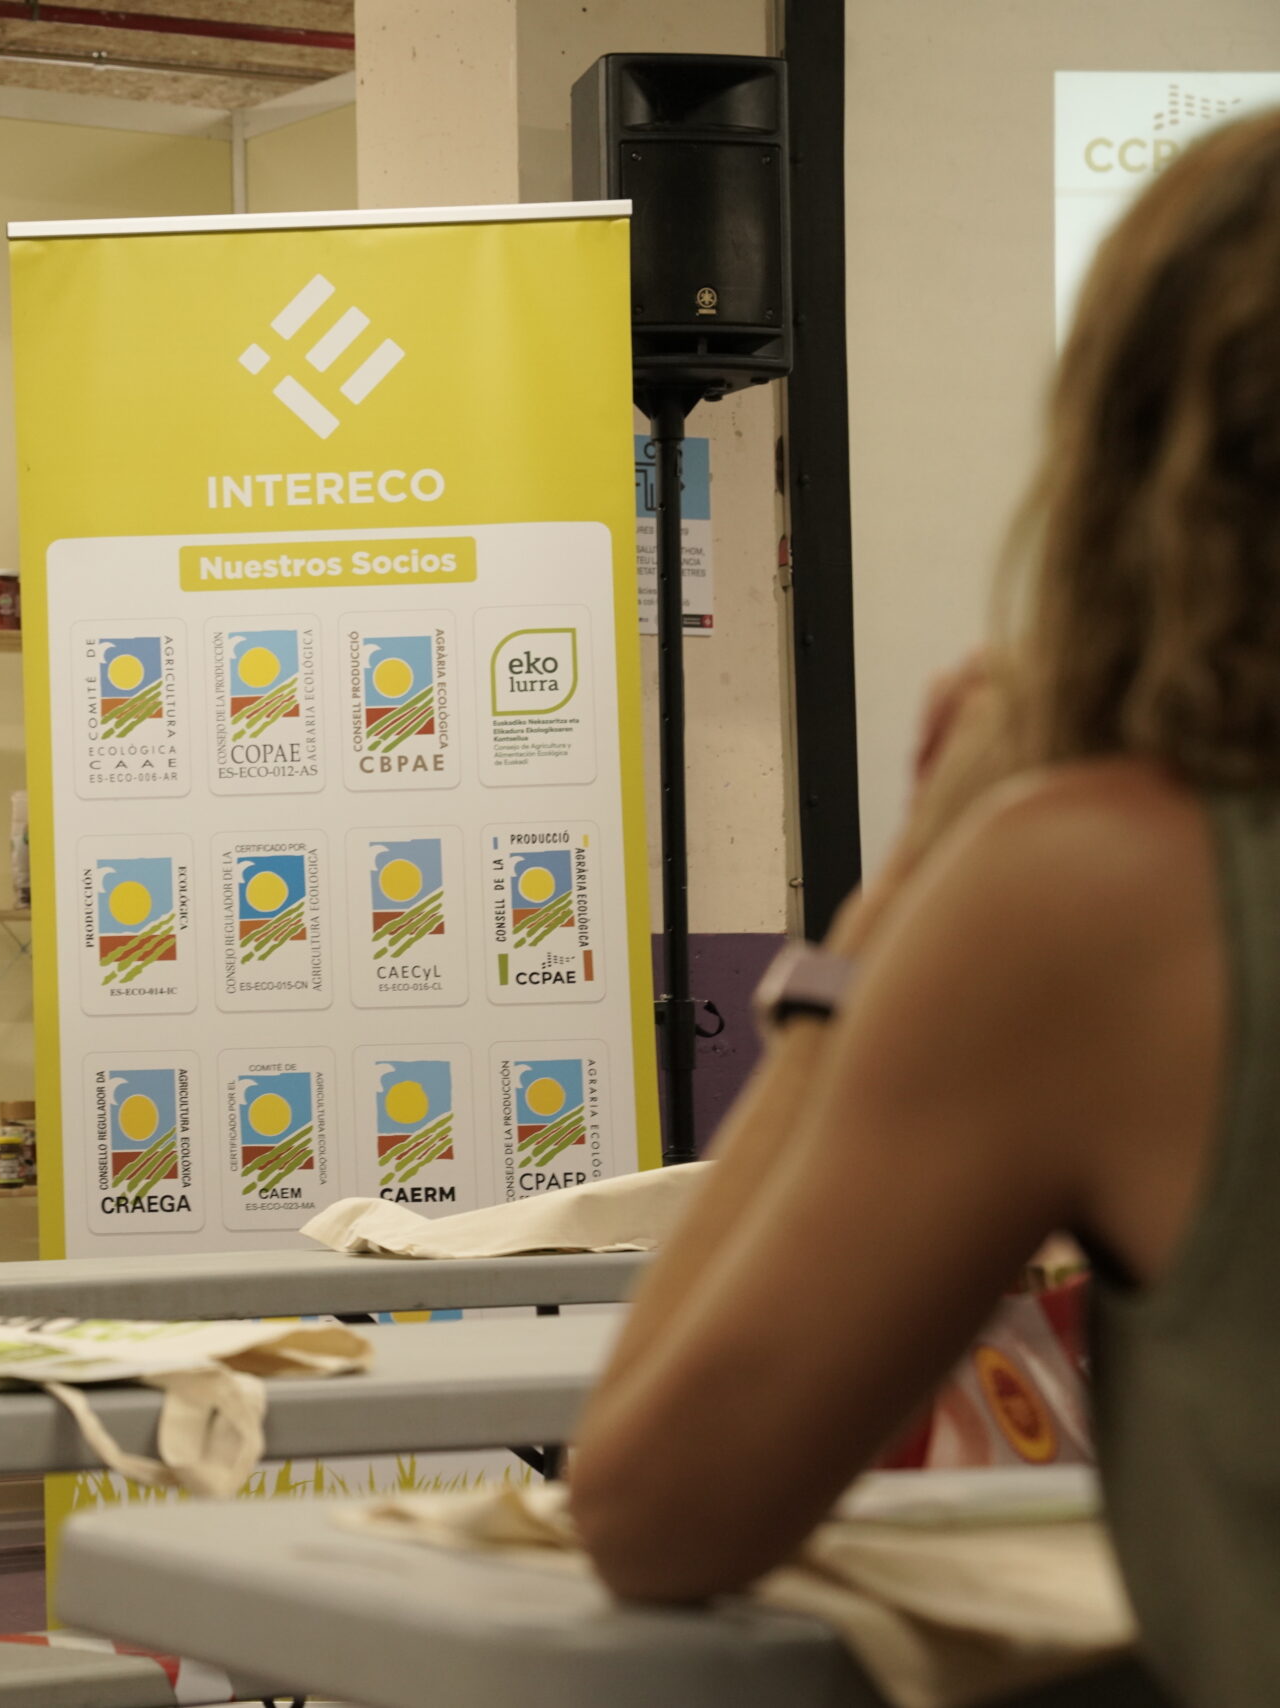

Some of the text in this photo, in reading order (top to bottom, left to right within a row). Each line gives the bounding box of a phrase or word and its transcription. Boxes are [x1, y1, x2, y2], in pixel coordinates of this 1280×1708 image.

[1084, 137, 1180, 173] CCP
[207, 468, 445, 510] INTERECO
[200, 547, 458, 581] Nuestros Socios
[508, 651, 559, 675] eko
[86, 639, 98, 741] COMITÉ DE
[164, 635, 176, 738] AGRICULTURA
[213, 631, 228, 765] CONSEJO DE LA PRODUCCIÓN
[303, 629, 317, 761] AGRARIA ECOLÓGICA
[348, 631, 363, 752] CONSELL PRODUCCIÓ
[509, 677, 560, 692] lurra
[230, 743, 301, 764] COPAE
[359, 754, 445, 774] CBPAE
[218, 765, 318, 779] ES-ECO-012-AS
[235, 844, 287, 853] CERTIFICADO
[510, 831, 570, 844] PRODUCCIÓ
[82, 869, 94, 948] PRODUCCIÓN
[493, 858, 506, 942] CONSELL DE LA
[222, 851, 237, 994] CONSEJO REGULADOR DE LA
[310, 916, 322, 991] AGRICULTURA
[376, 965, 442, 980] CAECyL
[516, 971, 576, 985] CCPAE
[285, 1063, 297, 1071] DE
[179, 1069, 189, 1132] AGRICULTURA
[500, 1060, 512, 1126] PRODUCCIÓN
[96, 1071, 109, 1190] CONSELLO REGULADOR DA
[227, 1080, 238, 1171] CERTIFICADO POR EL
[504, 1128, 513, 1140] LA
[588, 1059, 603, 1178] AGRARIA ECOLÓG
[504, 1143, 513, 1155] DE
[101, 1195, 191, 1214] CRAEGA
[259, 1188, 302, 1199] CAEM
[380, 1187, 456, 1202] CAERM
